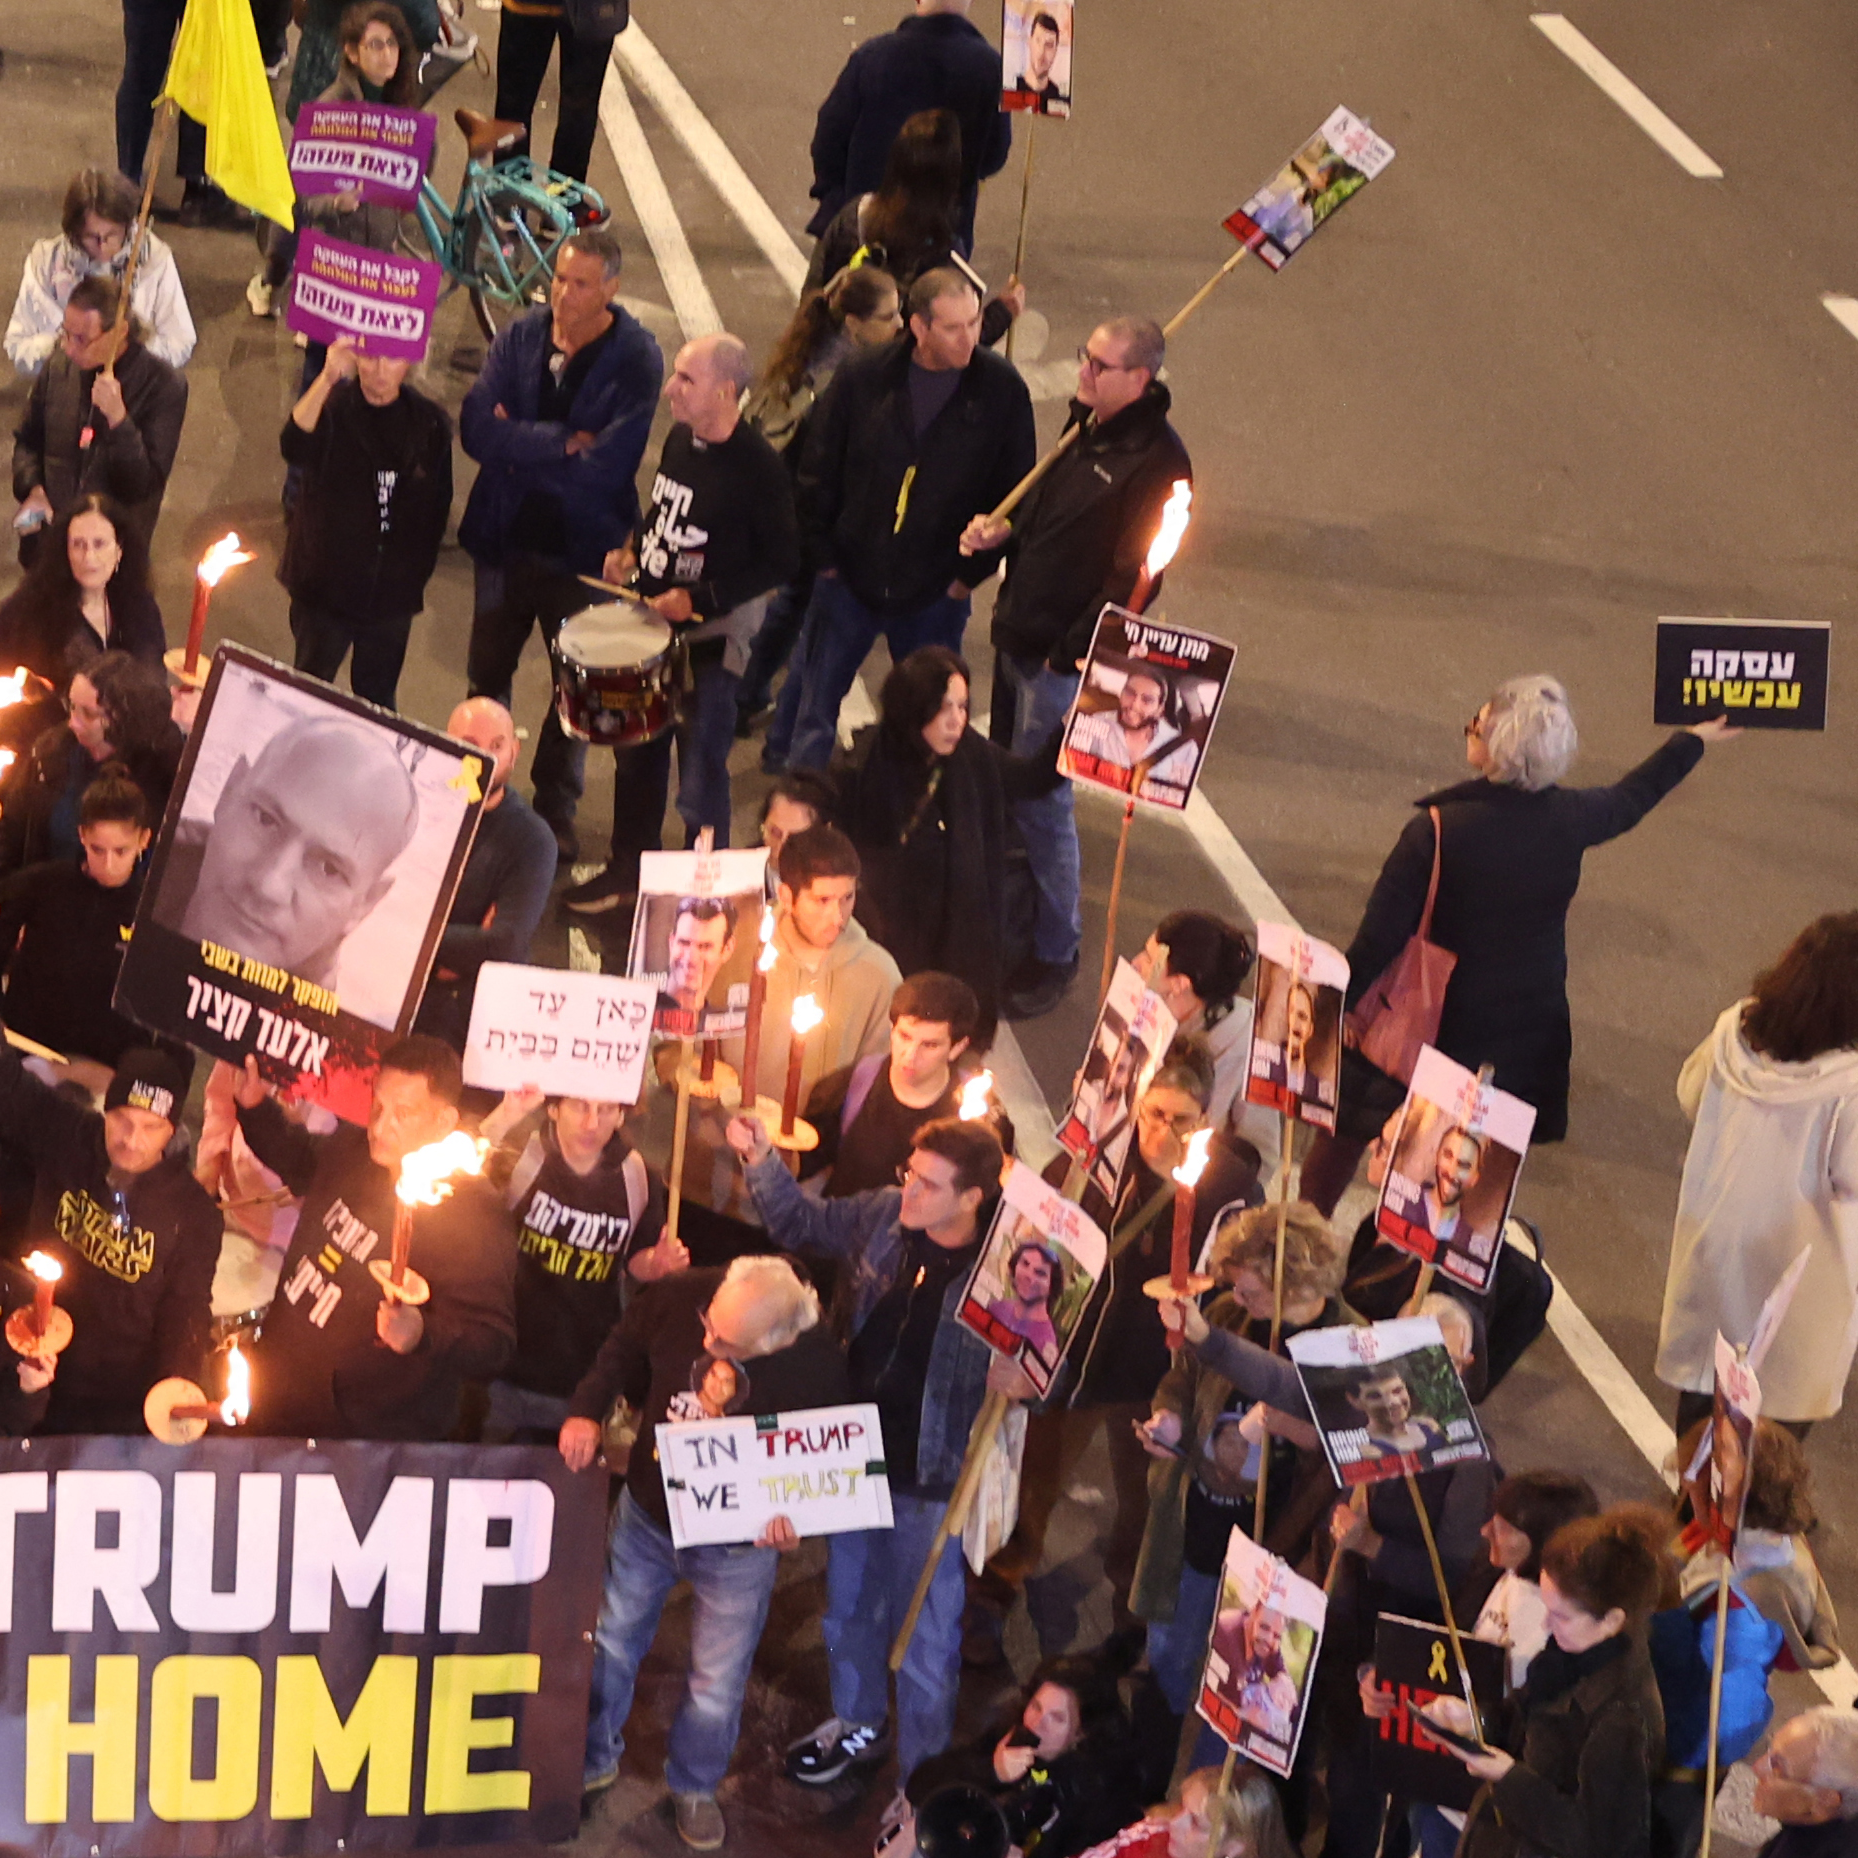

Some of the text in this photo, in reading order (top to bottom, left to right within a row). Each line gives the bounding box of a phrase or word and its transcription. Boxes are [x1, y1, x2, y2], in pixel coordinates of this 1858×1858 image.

[1690, 648, 1796, 682] עסקה
[1682, 677, 1802, 711] עכשיו!
[256, 1007, 331, 1077] אלעד
[685, 1421, 866, 1472] IN TRUMP
[690, 1466, 867, 1512] WE TRUST
[25, 1652, 541, 1825] HOME
